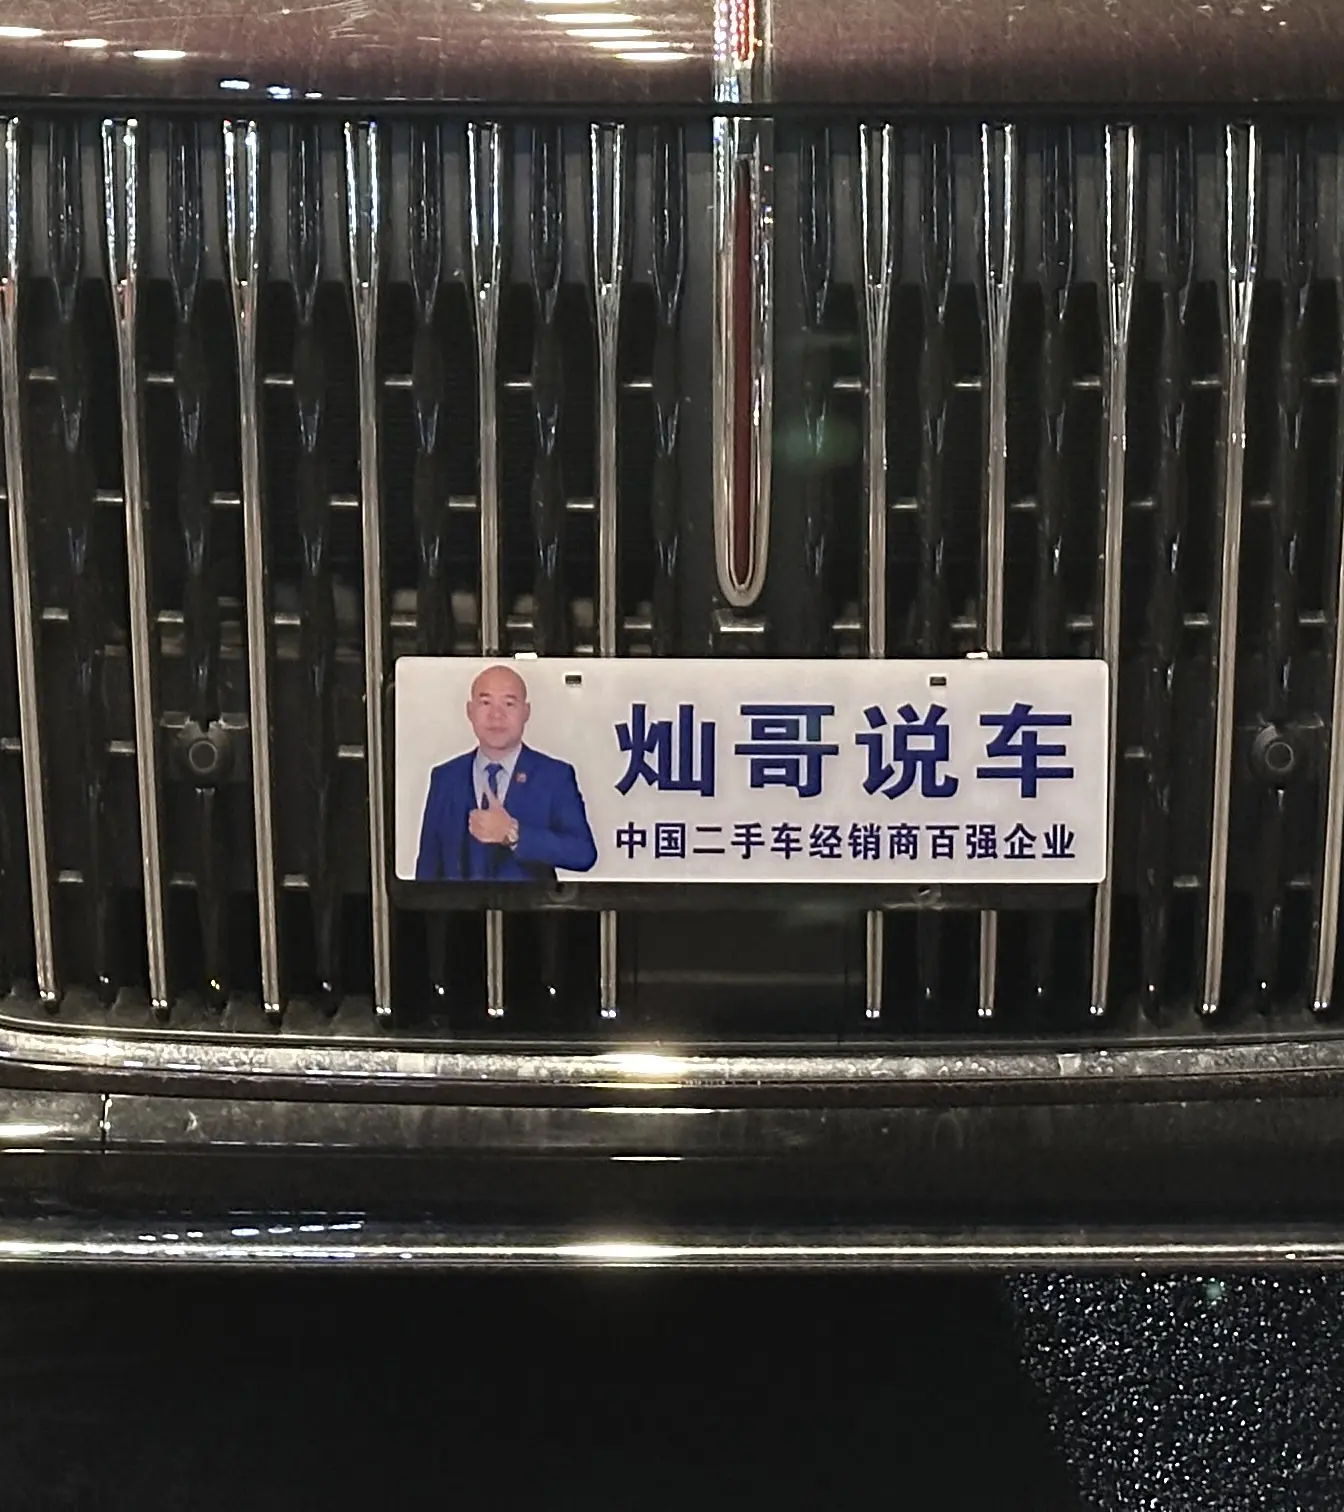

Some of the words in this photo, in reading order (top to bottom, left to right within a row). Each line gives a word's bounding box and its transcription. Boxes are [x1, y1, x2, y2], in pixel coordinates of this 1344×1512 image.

[614, 702, 1075, 800] 灿哥说车
[614, 821, 1076, 861] 中国二手车经销商百强企业
